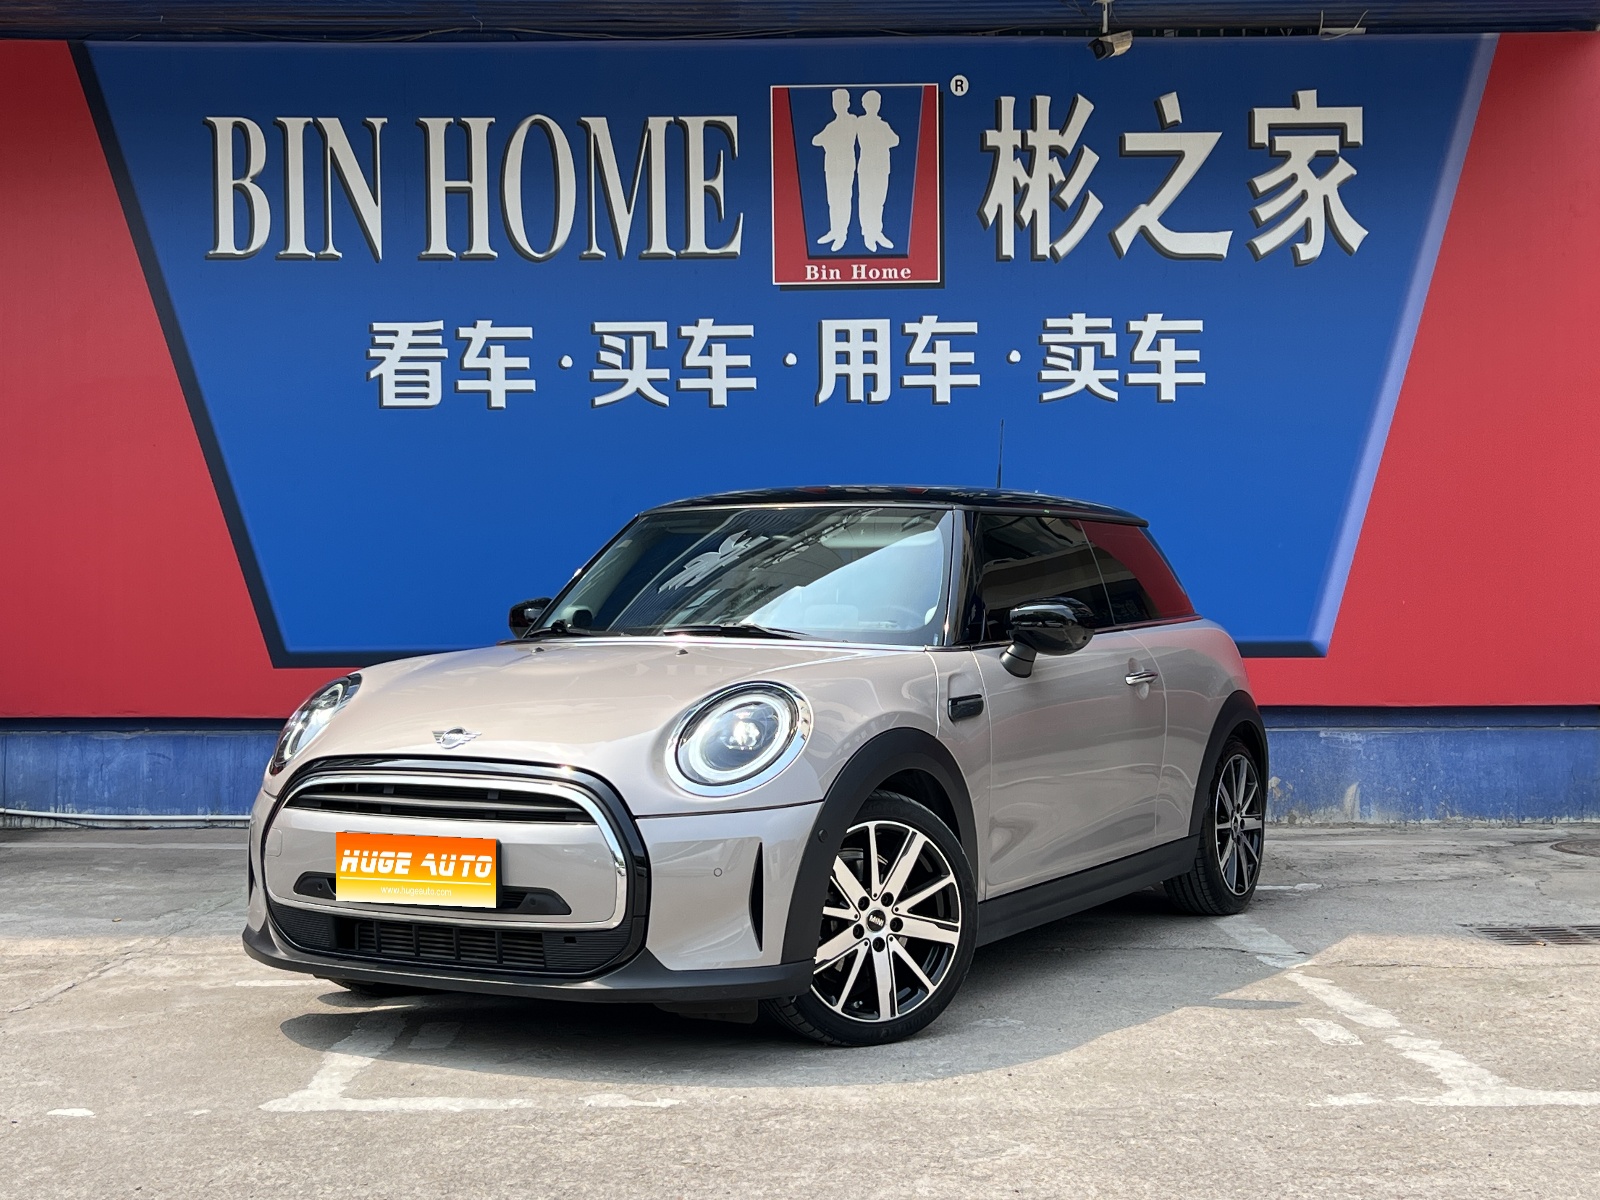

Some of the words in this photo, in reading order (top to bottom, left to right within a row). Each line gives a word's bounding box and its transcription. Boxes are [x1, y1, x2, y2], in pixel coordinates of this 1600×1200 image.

[205, 115, 389, 261] BIN
[416, 113, 744, 261] HOME
[977, 89, 1370, 266] 彬之家
[804, 264, 842, 280] Bin
[851, 264, 912, 280] Home
